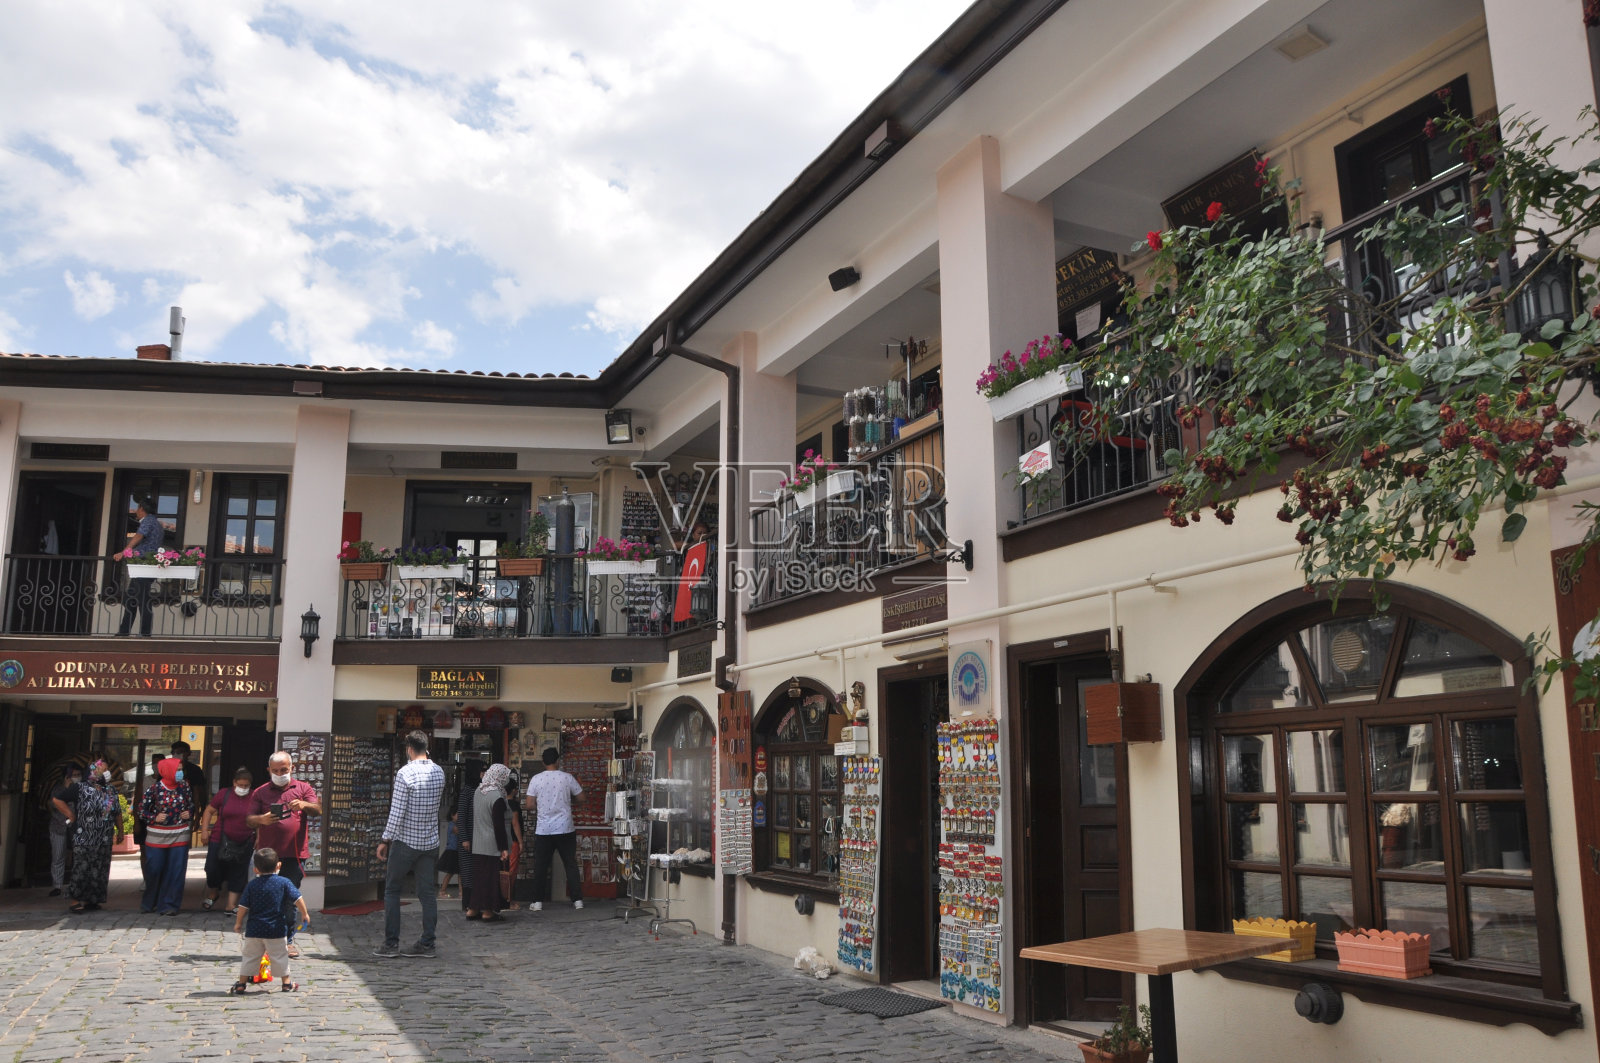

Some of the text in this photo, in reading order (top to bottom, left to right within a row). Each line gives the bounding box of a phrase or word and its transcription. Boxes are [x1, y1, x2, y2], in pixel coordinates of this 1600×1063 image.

[54, 661, 252, 677] ODUNPAZARI BELEDİYESİ
[430, 669, 486, 682] BAĞLAN
[27, 676, 274, 694] ATLIHAN EL SANATLARI ÇARŞISI
[459, 681, 495, 691] Hediyelik
